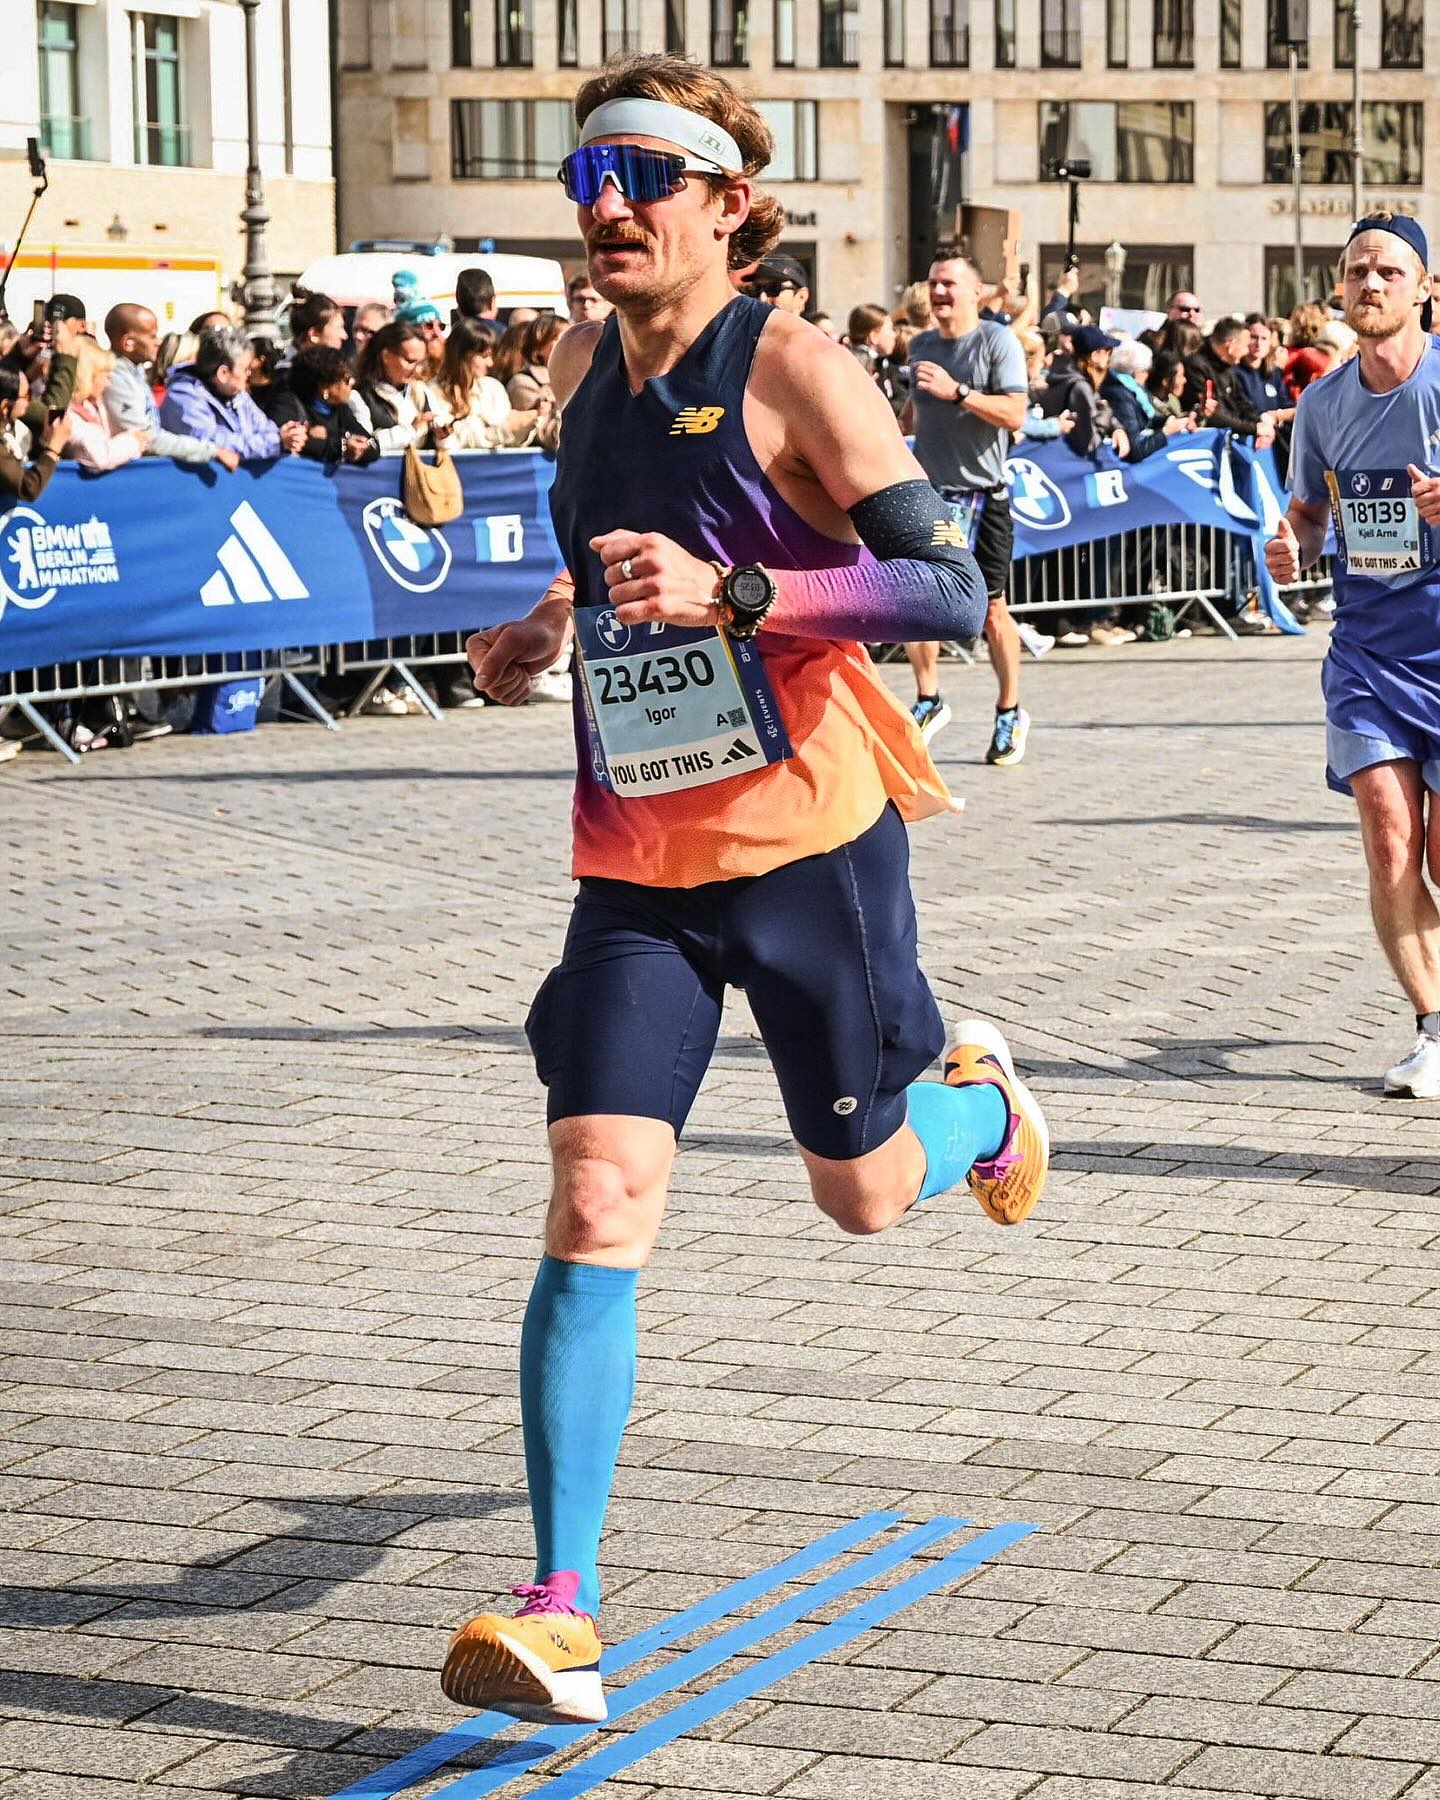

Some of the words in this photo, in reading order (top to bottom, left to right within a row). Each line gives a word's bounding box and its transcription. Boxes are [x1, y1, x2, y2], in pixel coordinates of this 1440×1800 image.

[784, 209, 817, 226] tut
[1347, 501, 1407, 524] 18139
[32, 523, 82, 551] BMW
[1376, 528, 1398, 538] Arne
[35, 548, 89, 570] BERLIN
[1349, 557, 1363, 568] YOU
[1365, 557, 1378, 568] GOT
[1379, 557, 1398, 569] THIS
[38, 564, 120, 588] MARATHON
[594, 649, 715, 706] 23430
[645, 706, 677, 726] Igor
[716, 713, 729, 727] A
[610, 764, 637, 785] YOU
[639, 759, 670, 782] GOT
[671, 751, 714, 776] THIS
